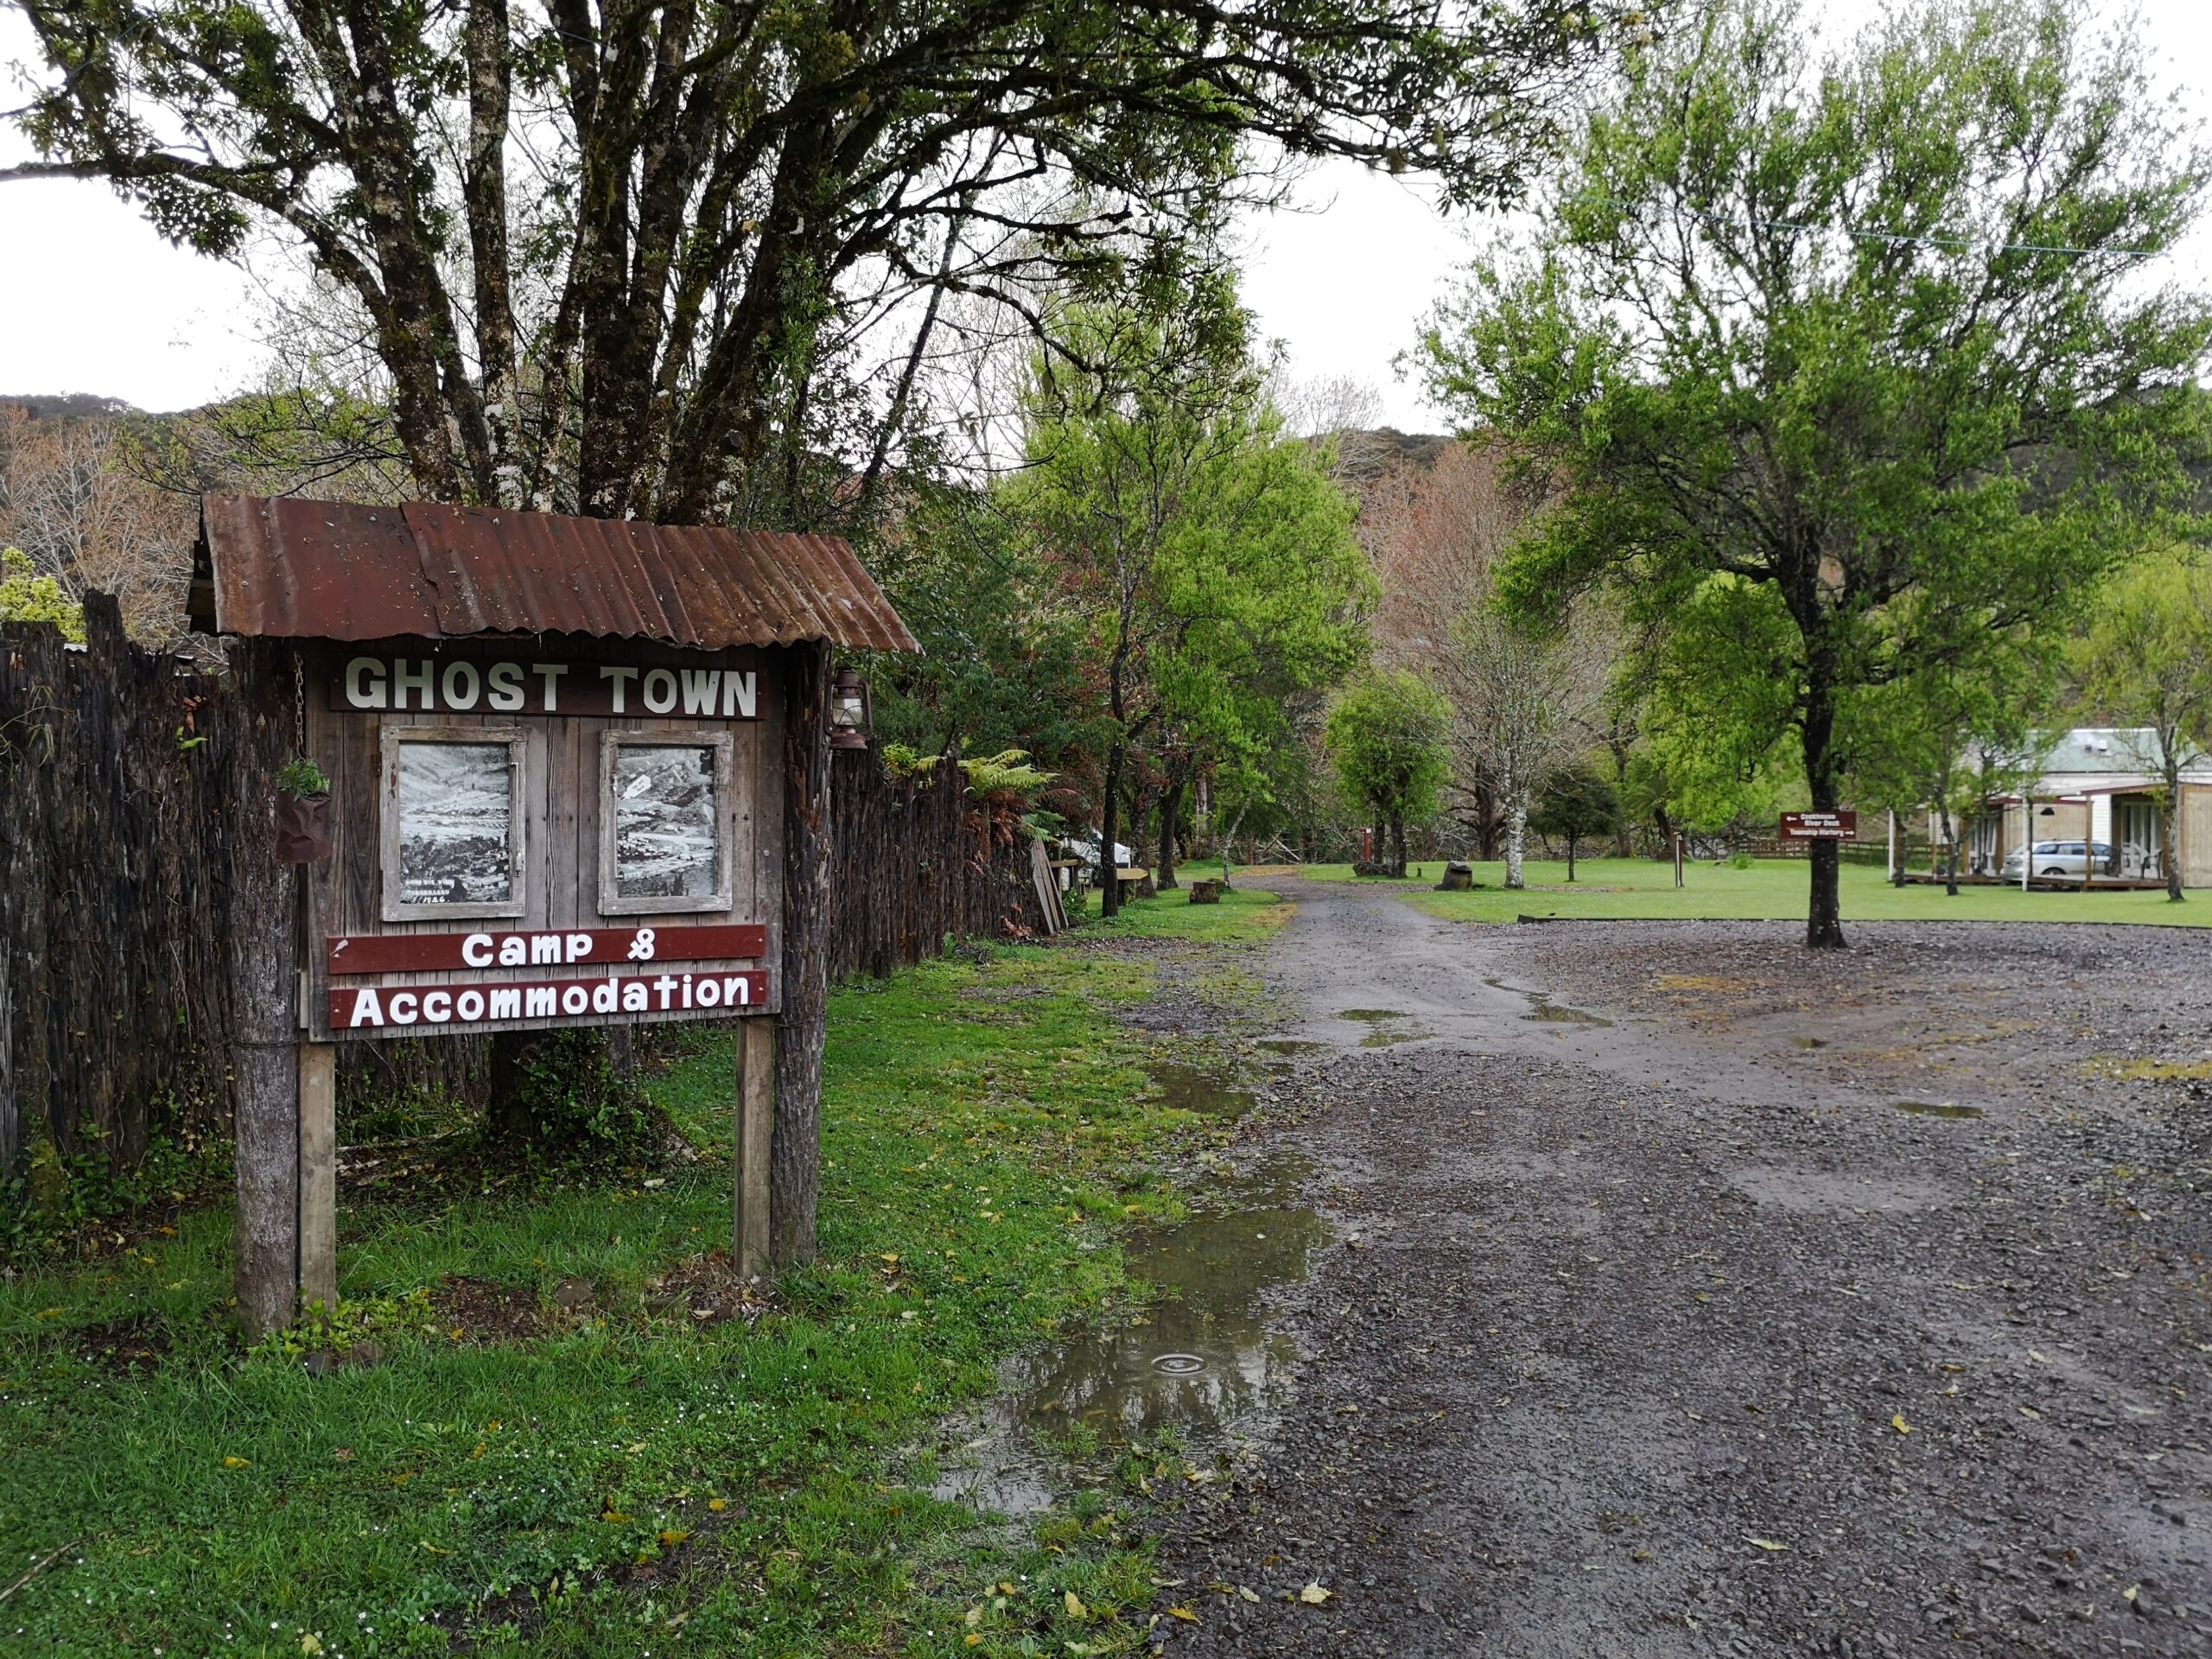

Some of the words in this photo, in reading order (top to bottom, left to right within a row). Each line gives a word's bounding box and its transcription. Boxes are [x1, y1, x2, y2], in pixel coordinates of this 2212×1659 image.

[346, 657, 569, 711] GHOST
[600, 666, 757, 717] TOWN
[462, 929, 593, 967] Camp
[627, 928, 656, 960] &
[350, 975, 749, 1027] Accommodation
